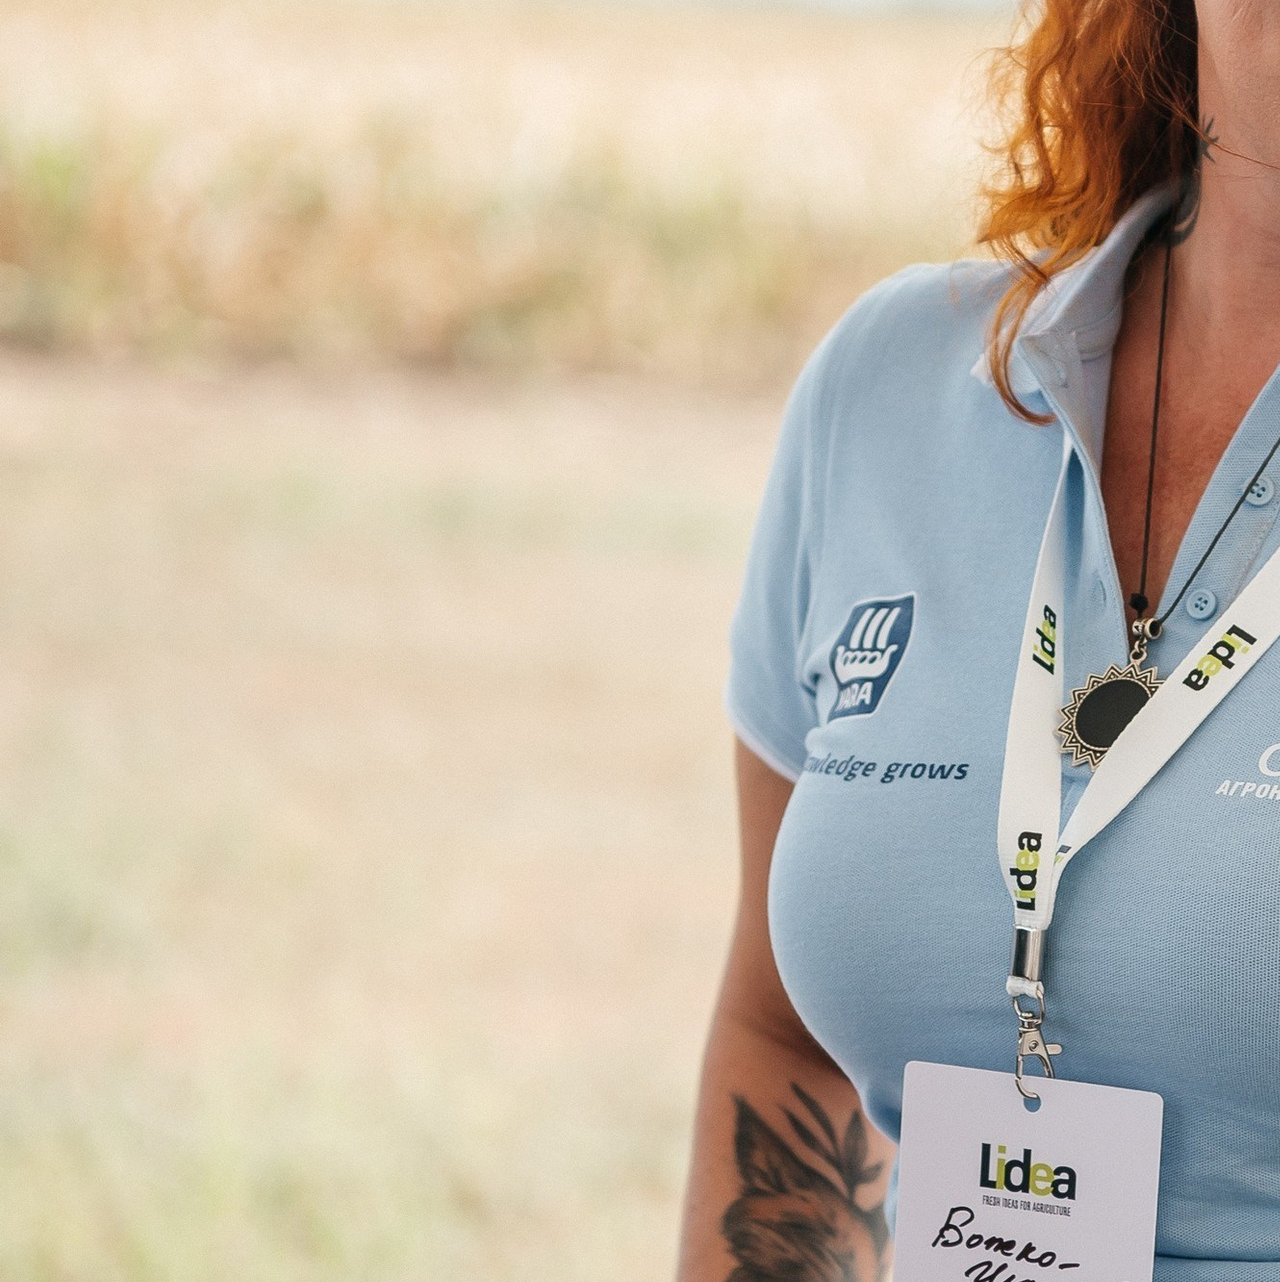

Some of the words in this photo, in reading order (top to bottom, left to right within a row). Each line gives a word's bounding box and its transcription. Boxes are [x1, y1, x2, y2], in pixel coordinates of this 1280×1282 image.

[880, 762, 970, 784] grows
[980, 1143, 1076, 1200] Lidea
[982, 1195, 1001, 1207] FRESH
[1002, 1197, 1019, 1210] IDEAS
[1020, 1200, 1031, 1211] FOR
[1032, 1202, 1071, 1217] AGRICULTURE
